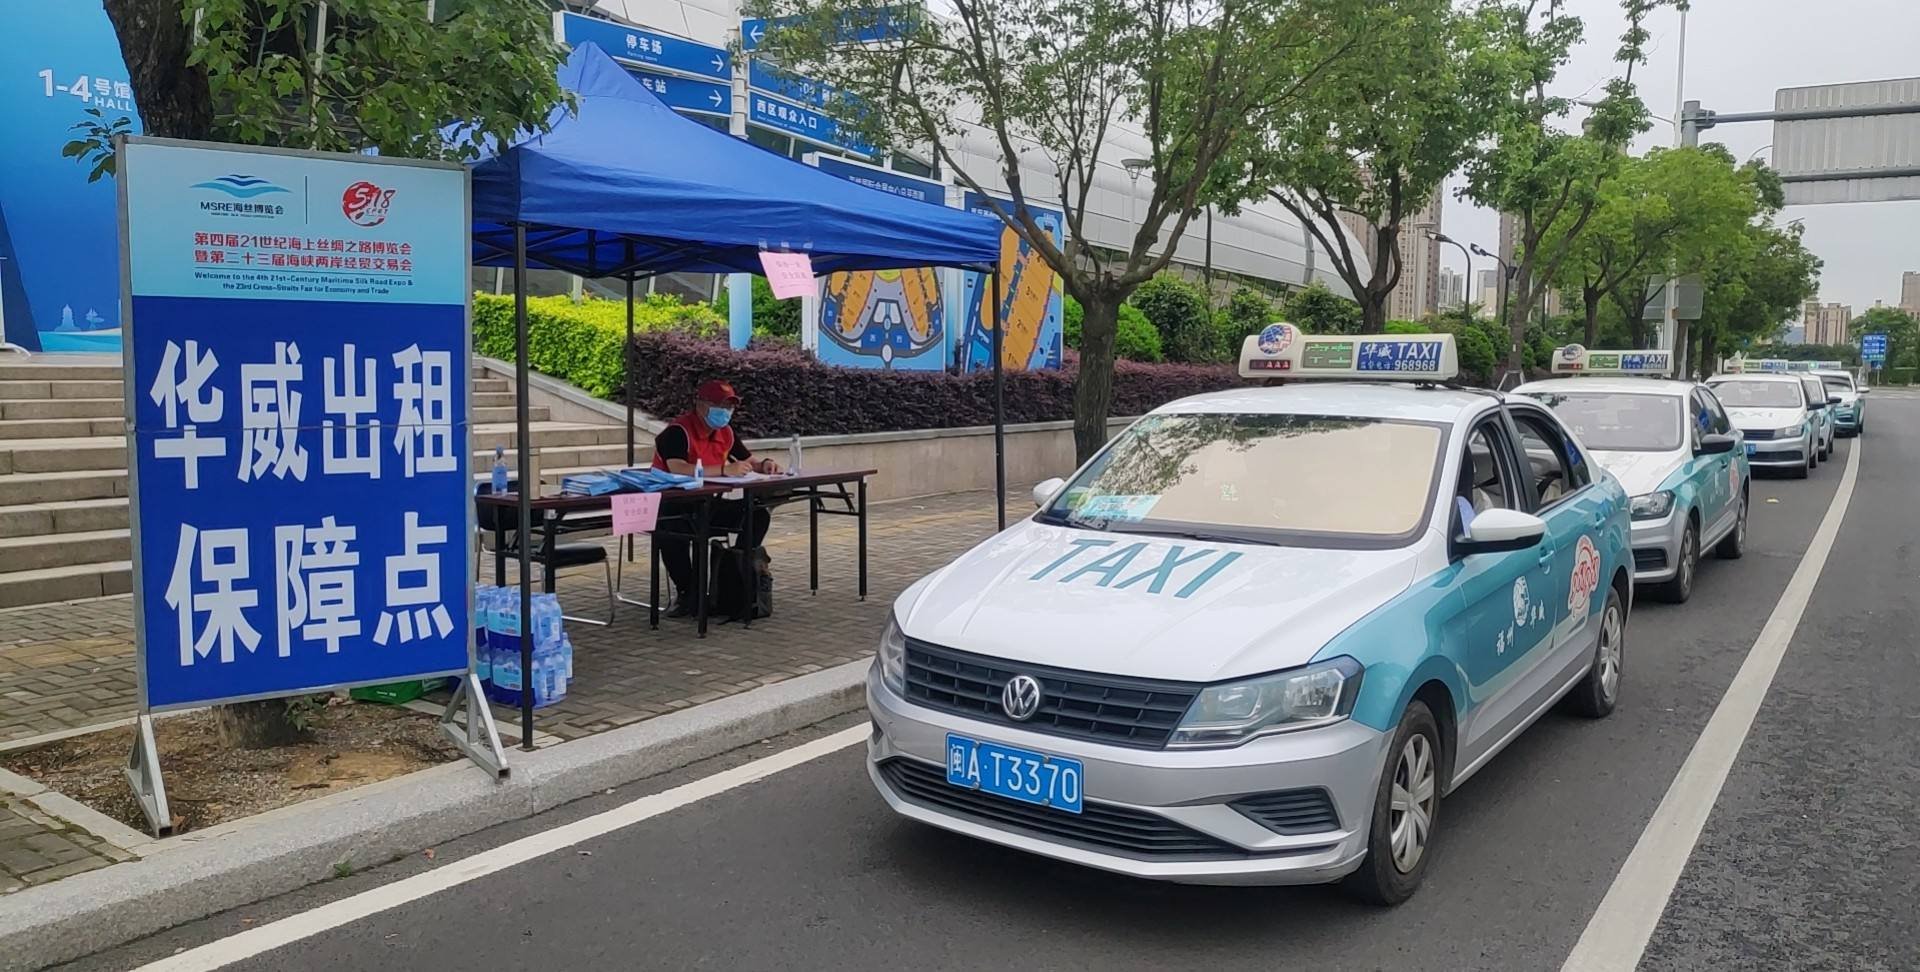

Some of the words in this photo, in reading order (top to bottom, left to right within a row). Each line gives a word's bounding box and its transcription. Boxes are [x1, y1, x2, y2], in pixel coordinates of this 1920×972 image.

[626, 34, 662, 54] 停车场
[637, 77, 667, 93] 车站
[95, 96, 132, 111] HALL
[756, 99, 817, 129] 西区观众入口
[194, 232, 412, 255] 第四届21世纪海上丝绸之路博览会
[194, 249, 412, 272] 暨第二十三届海峡两岸经贸交易会
[195, 271, 231, 280] Welcome
[233, 272, 241, 280] to
[242, 273, 255, 281] the
[270, 274, 320, 283] 21st-Century
[321, 276, 354, 284] Maritime
[355, 277, 368, 285] Silk
[389, 279, 407, 287] Expo
[325, 286, 356, 294] Economy
[1361, 343, 1393, 360] 华威
[1397, 343, 1438, 360] TAXI
[1394, 360, 1436, 371] 968968
[150, 339, 457, 489] 华威出租
[1028, 538, 1244, 599] TAXI
[165, 511, 454, 666] 保障点
[951, 744, 1078, 803] 闽A·T3370
